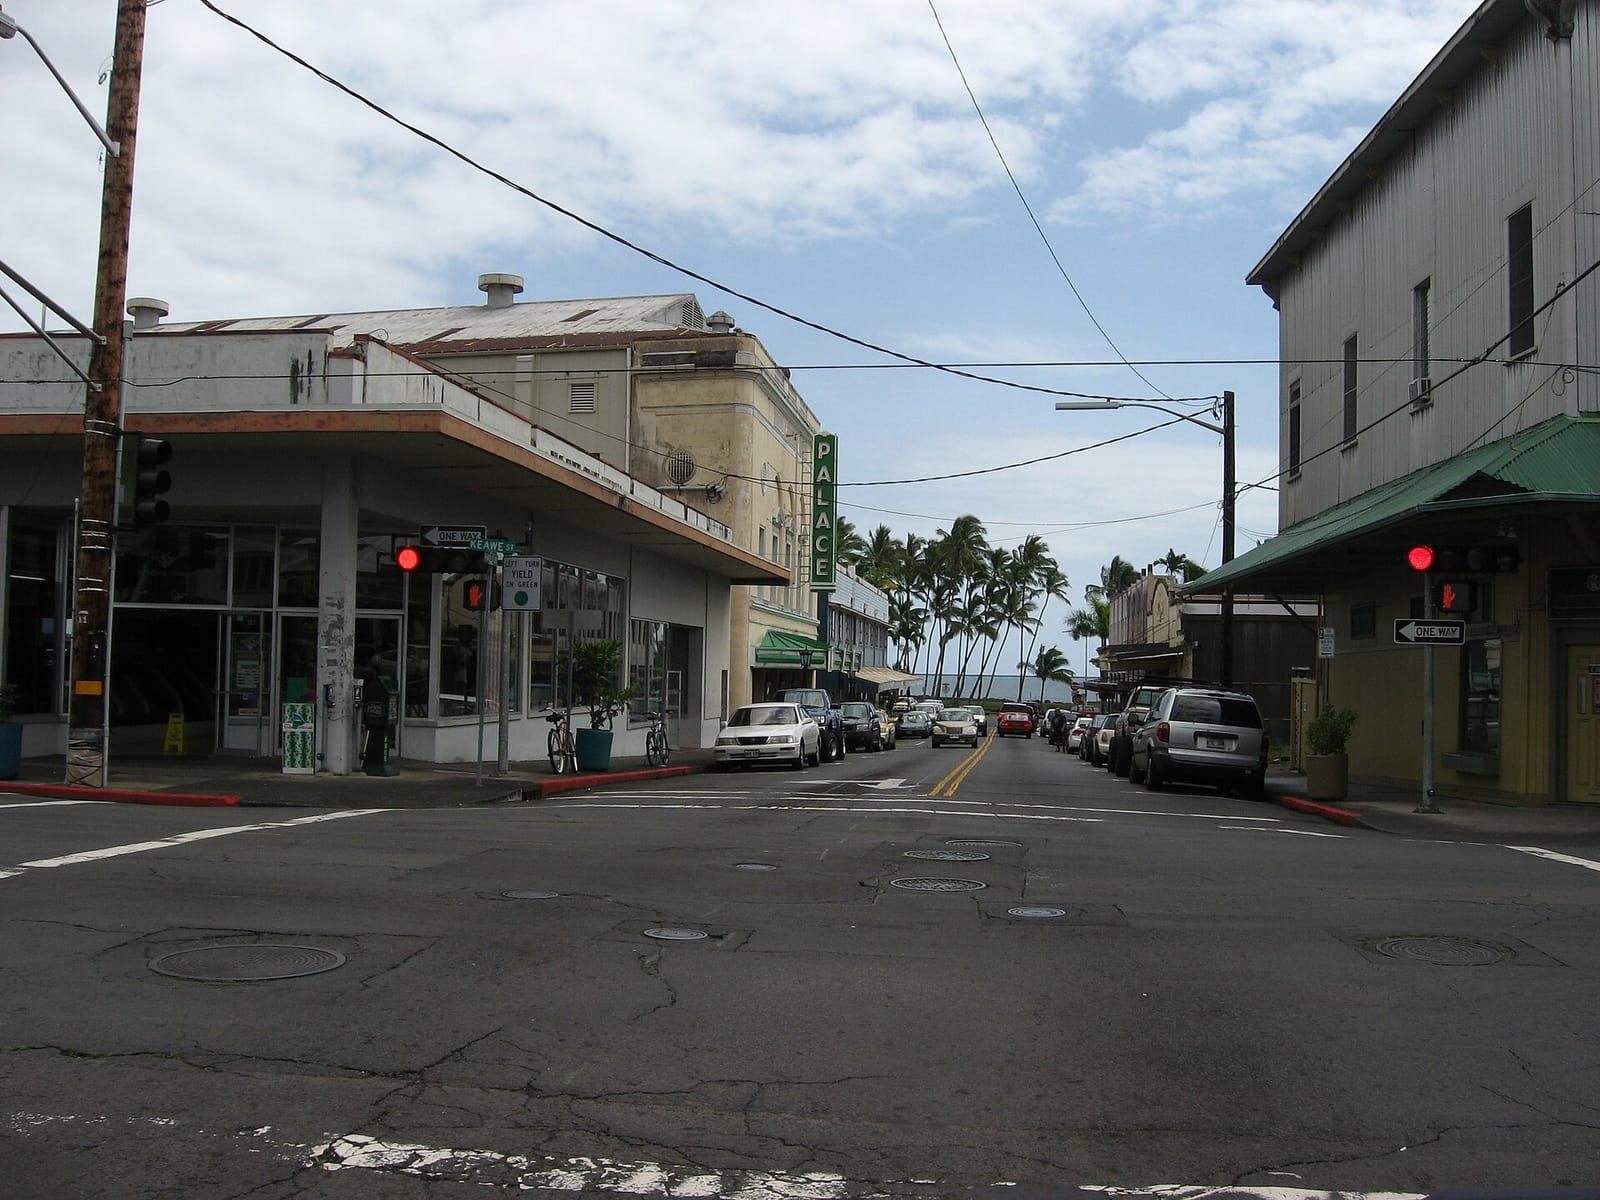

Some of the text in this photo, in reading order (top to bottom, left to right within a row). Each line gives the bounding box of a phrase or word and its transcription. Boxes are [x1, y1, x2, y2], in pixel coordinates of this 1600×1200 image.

[816, 442, 832, 576] PALACE
[439, 532, 480, 540] ONE WAY
[470, 540, 504, 551] KEAWE
[511, 570, 533, 578] YIELD
[1416, 627, 1457, 636] ONE WAY
